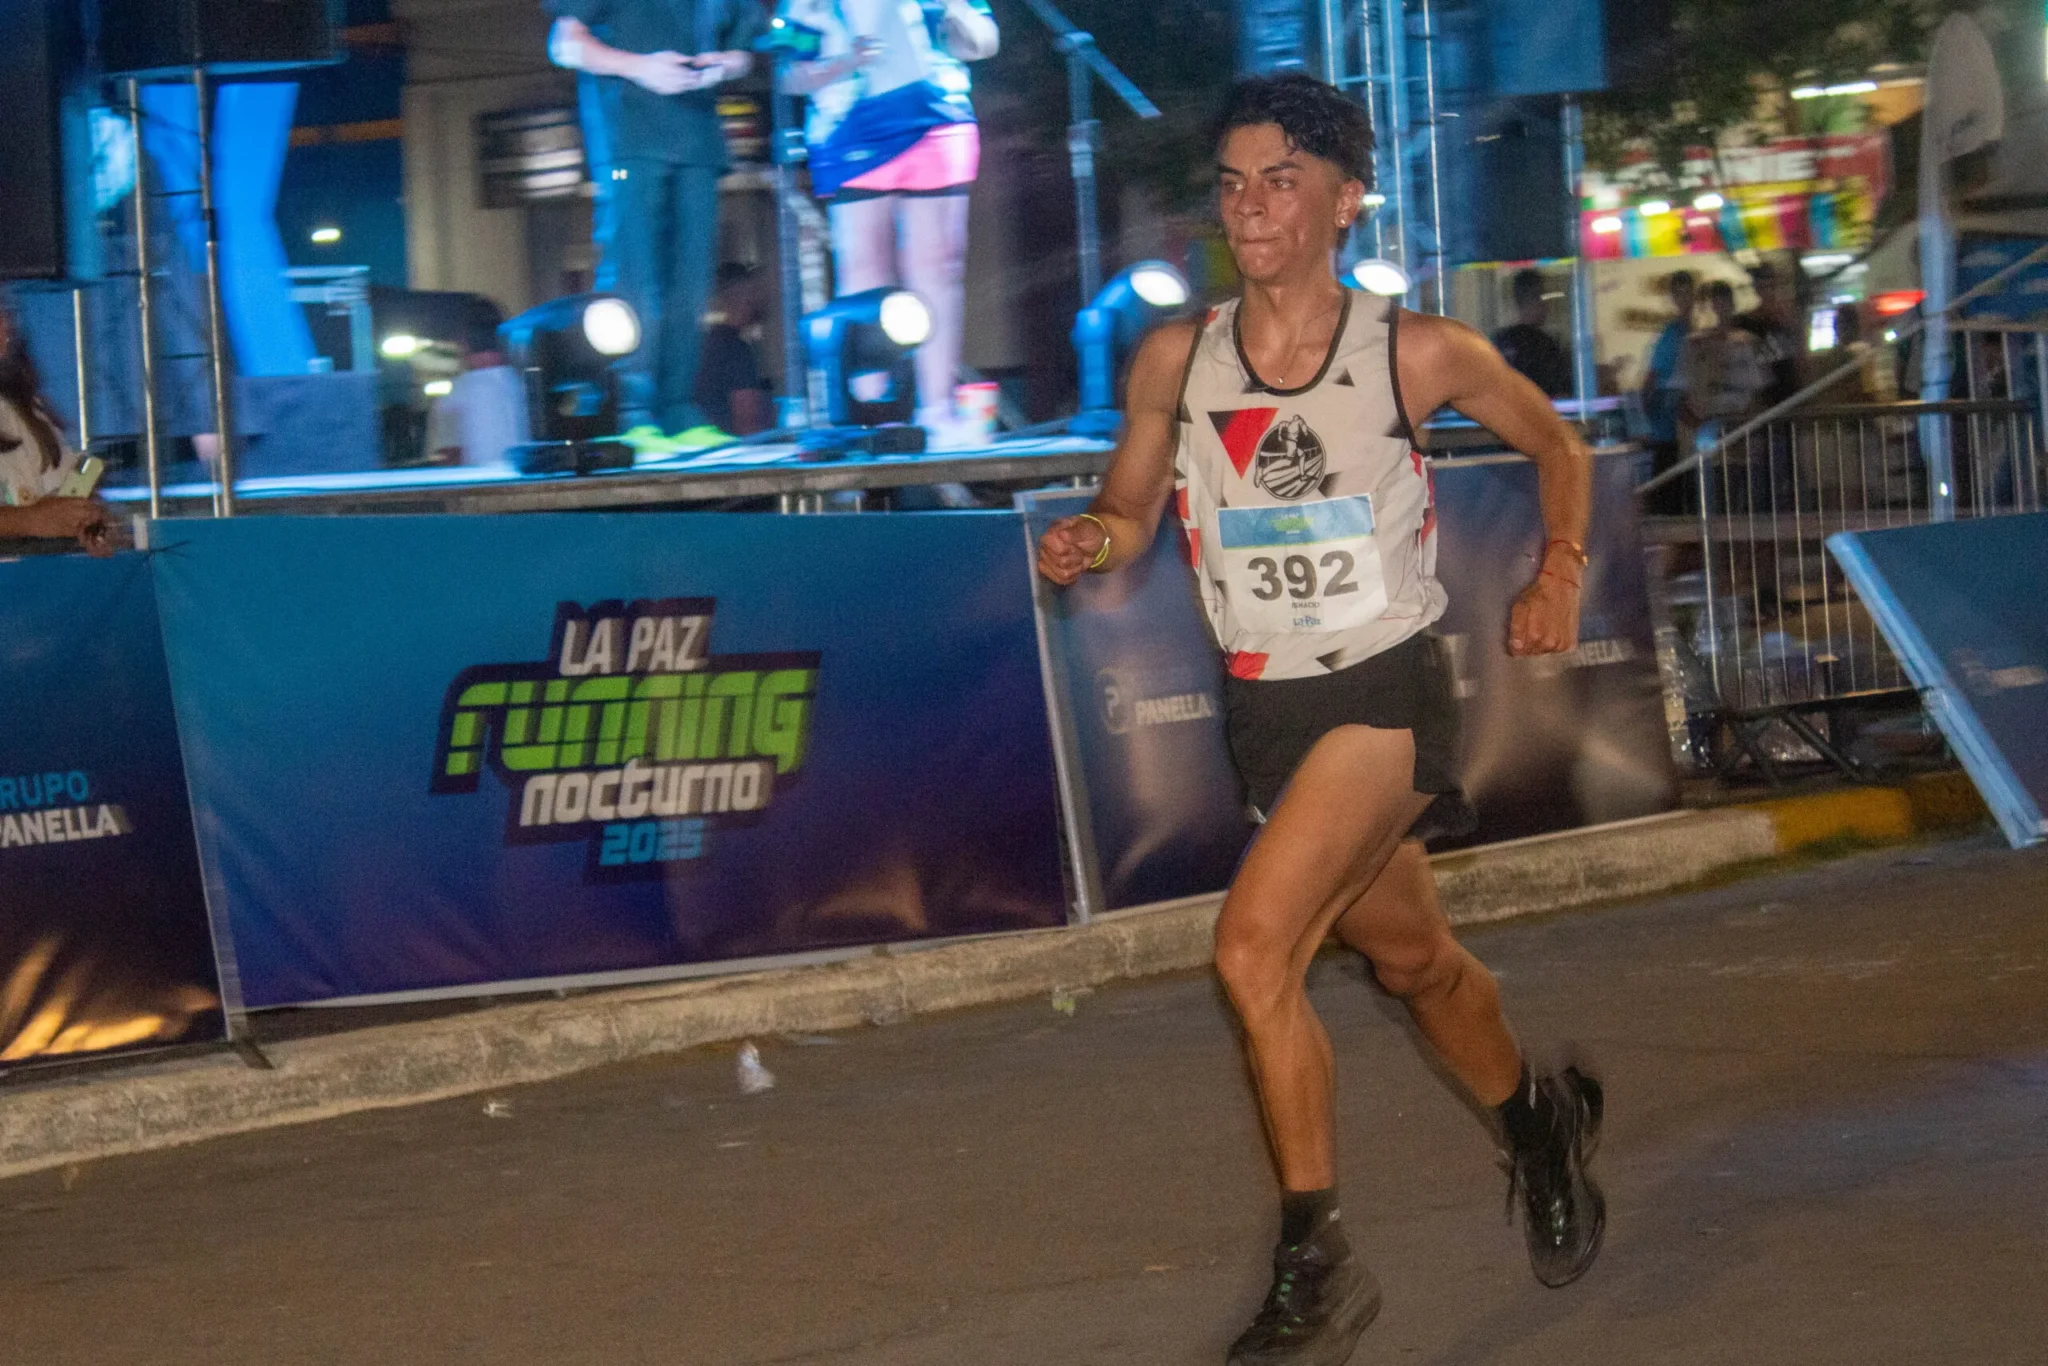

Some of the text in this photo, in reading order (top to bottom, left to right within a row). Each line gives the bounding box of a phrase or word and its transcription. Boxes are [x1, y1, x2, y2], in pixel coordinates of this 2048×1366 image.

[1247, 550, 1359, 601] 392
[559, 615, 704, 677] LA PAZ
[520, 759, 768, 827] nocturno
[600, 820, 704, 866] 2025
